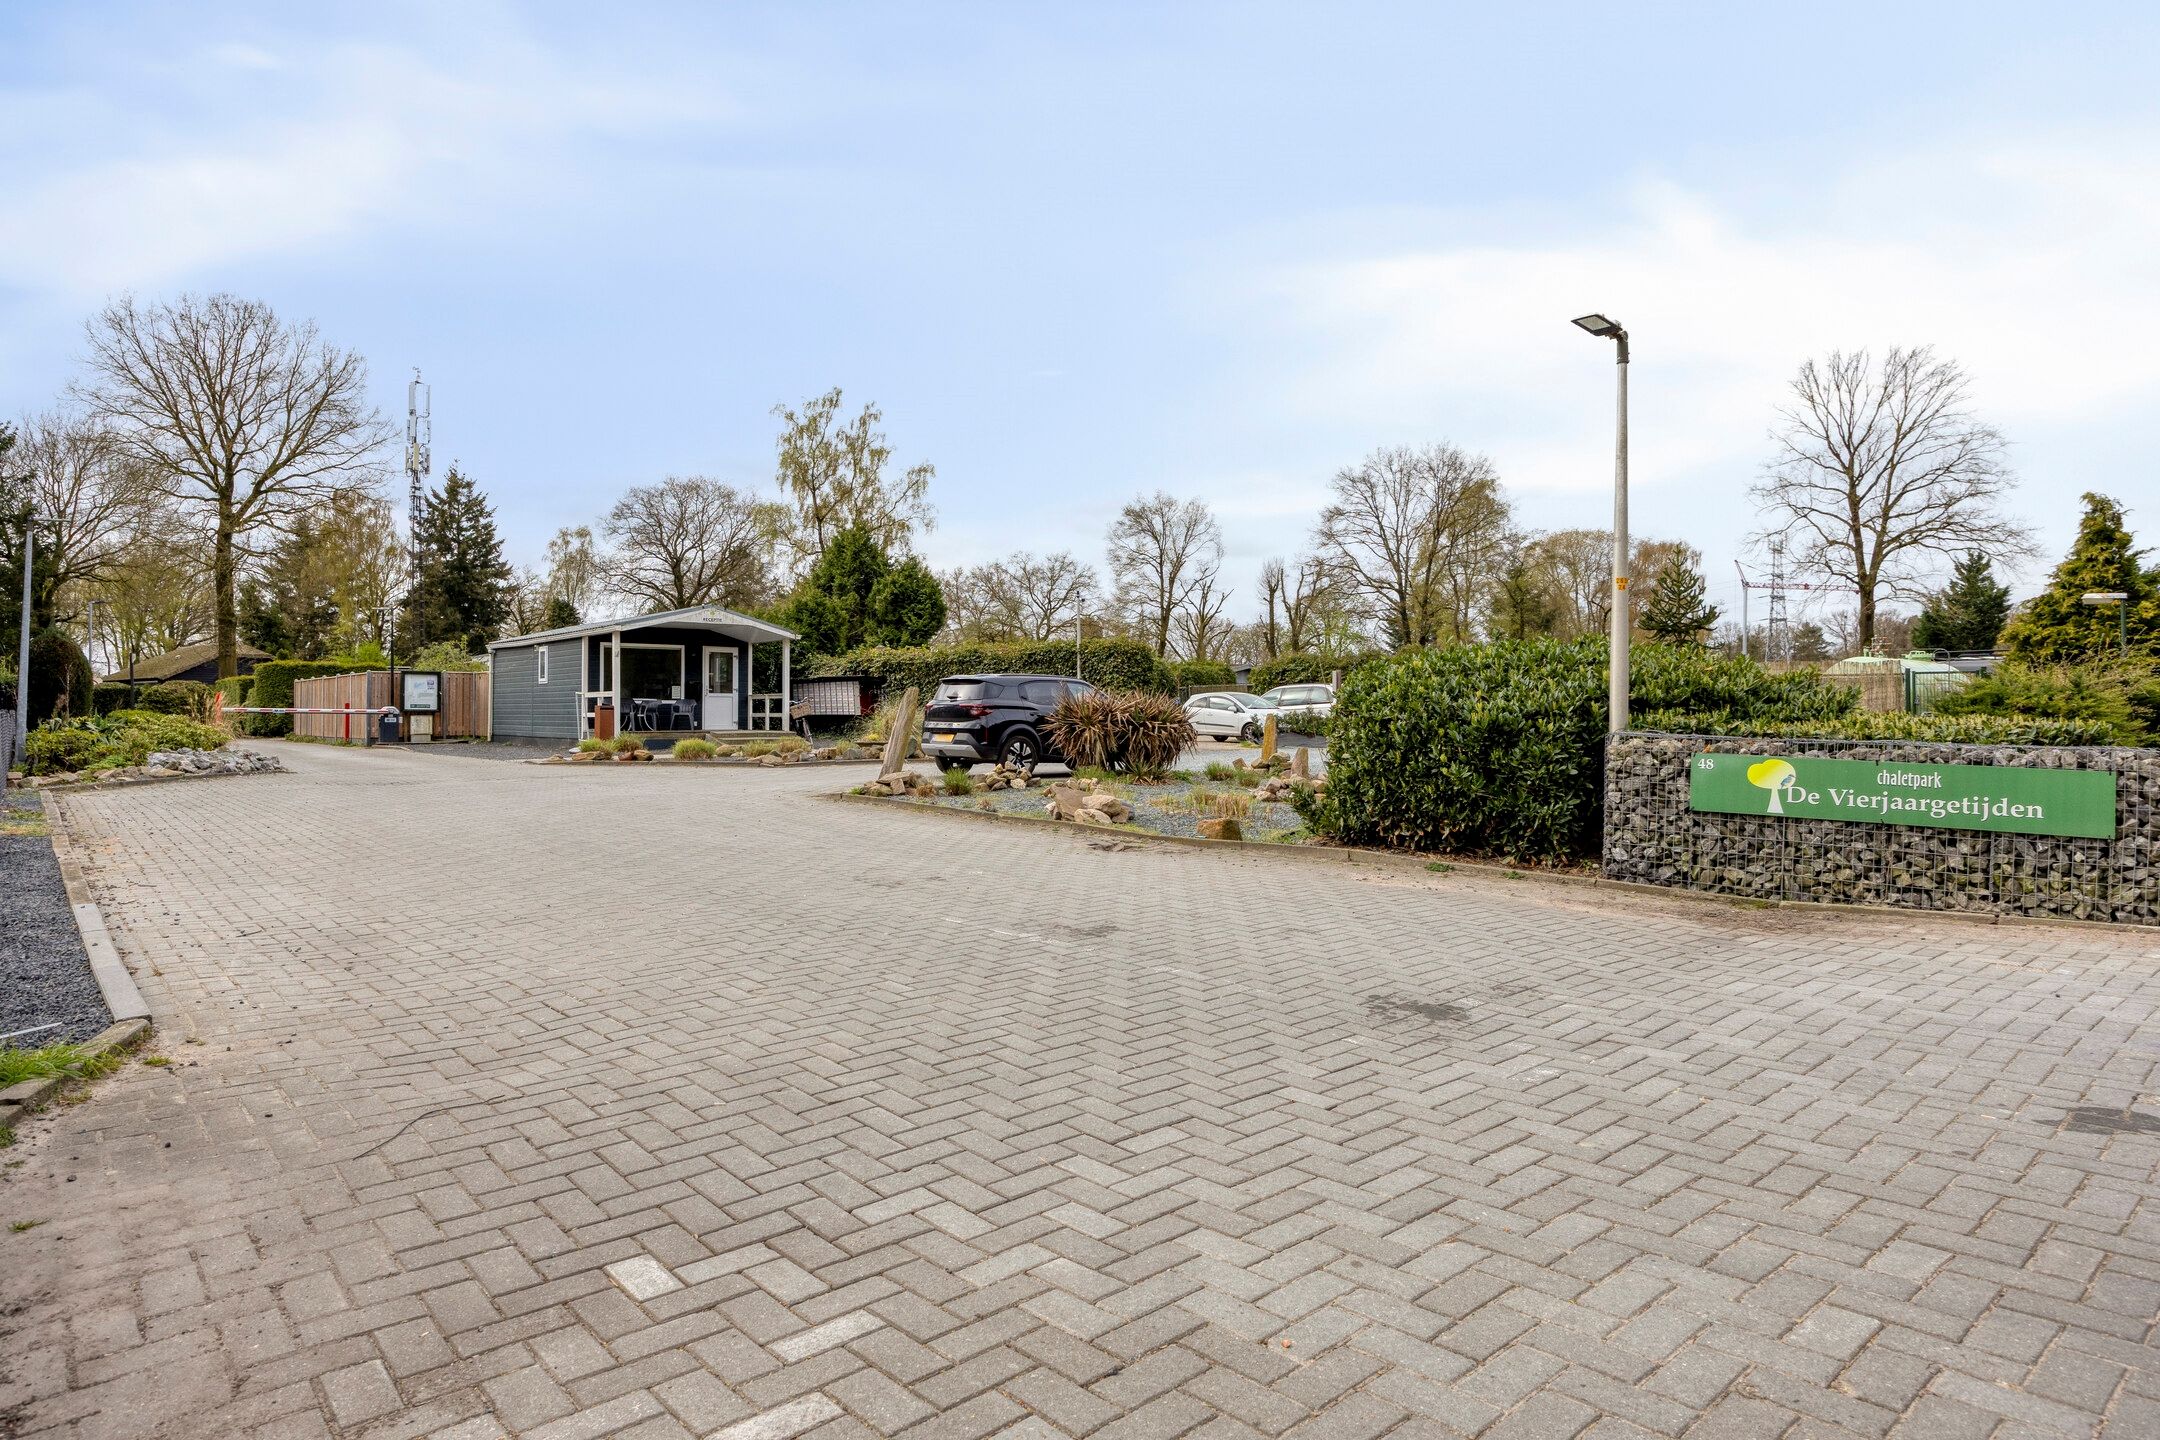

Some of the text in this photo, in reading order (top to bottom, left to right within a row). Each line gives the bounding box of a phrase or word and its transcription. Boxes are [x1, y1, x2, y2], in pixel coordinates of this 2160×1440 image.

[1697, 758, 1714, 770] 48
[1876, 769, 1943, 790] chaletpark
[1786, 786, 2045, 822] De Vierjaargetijden
